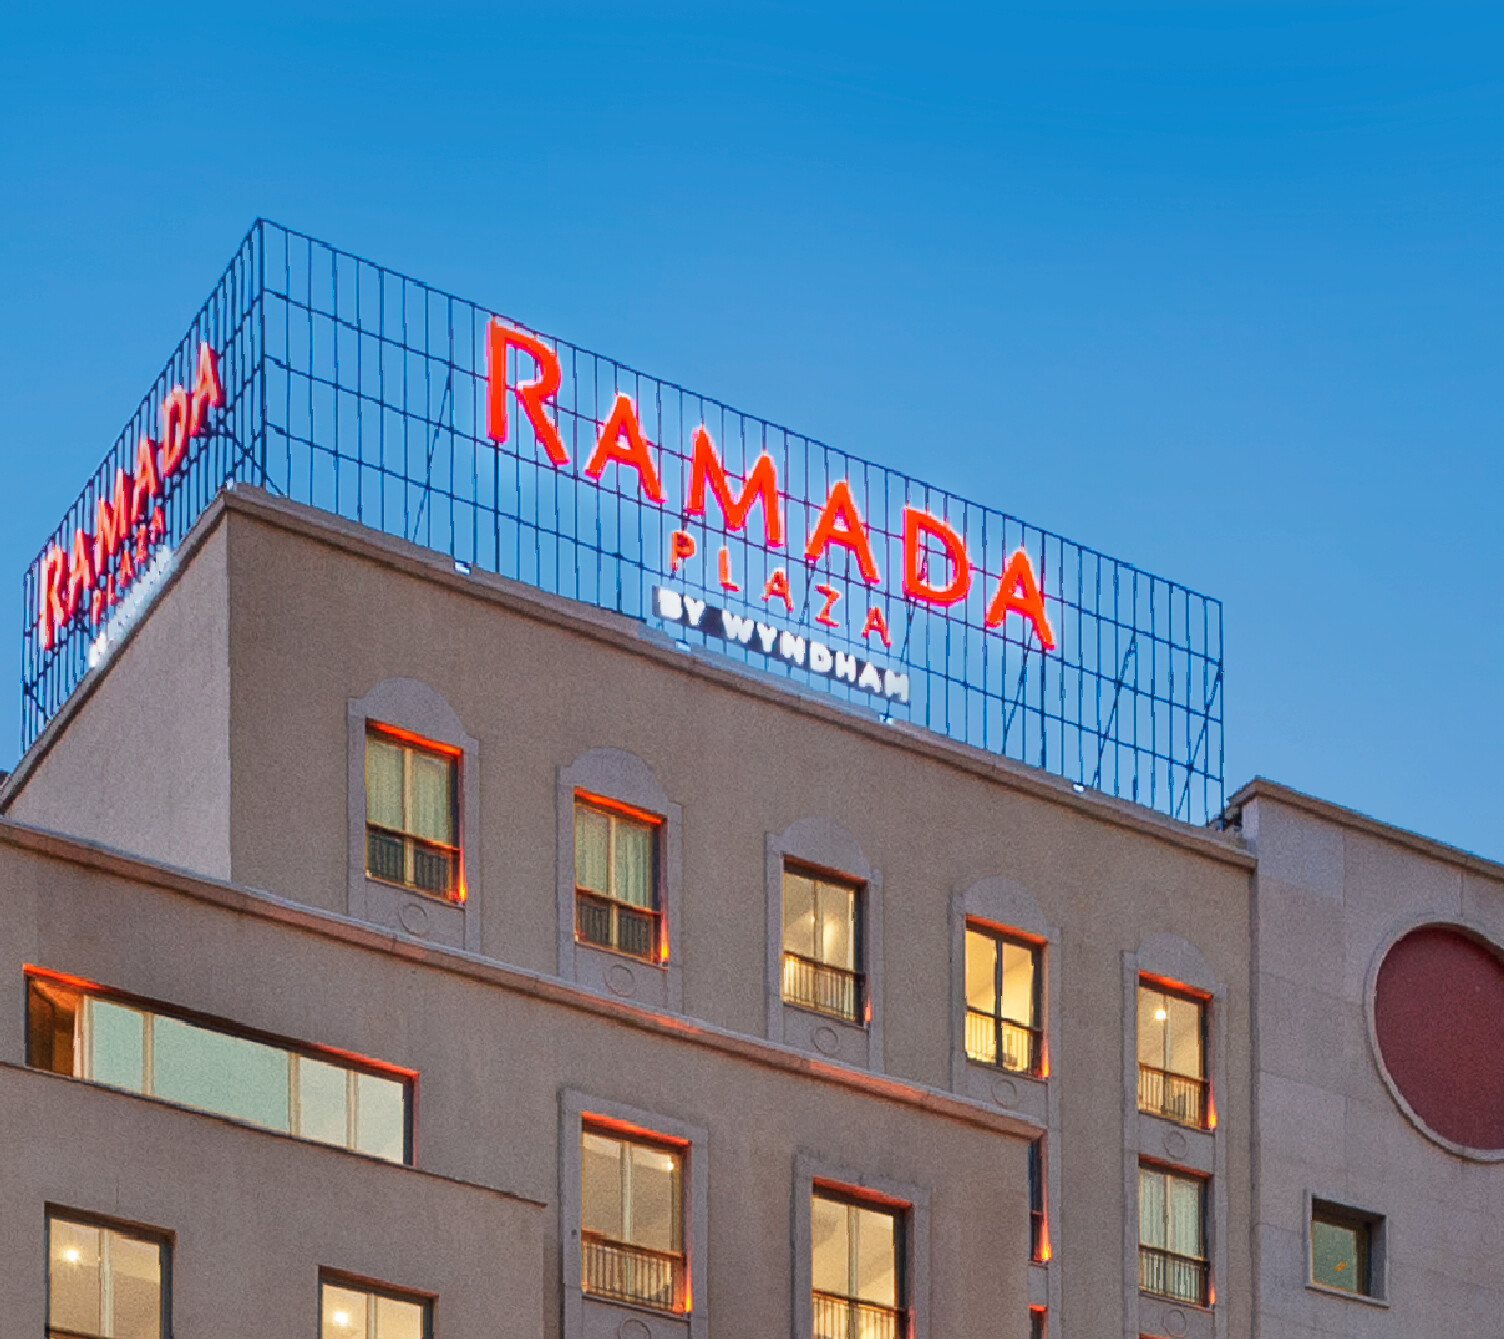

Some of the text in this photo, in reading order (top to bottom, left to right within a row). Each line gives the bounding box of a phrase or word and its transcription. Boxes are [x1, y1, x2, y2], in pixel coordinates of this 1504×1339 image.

[40, 341, 223, 651] RAMADA
[485, 313, 1056, 651] RAMADA
[669, 530, 892, 648] PLAZA
[658, 588, 911, 702] BY WYNDHAM
